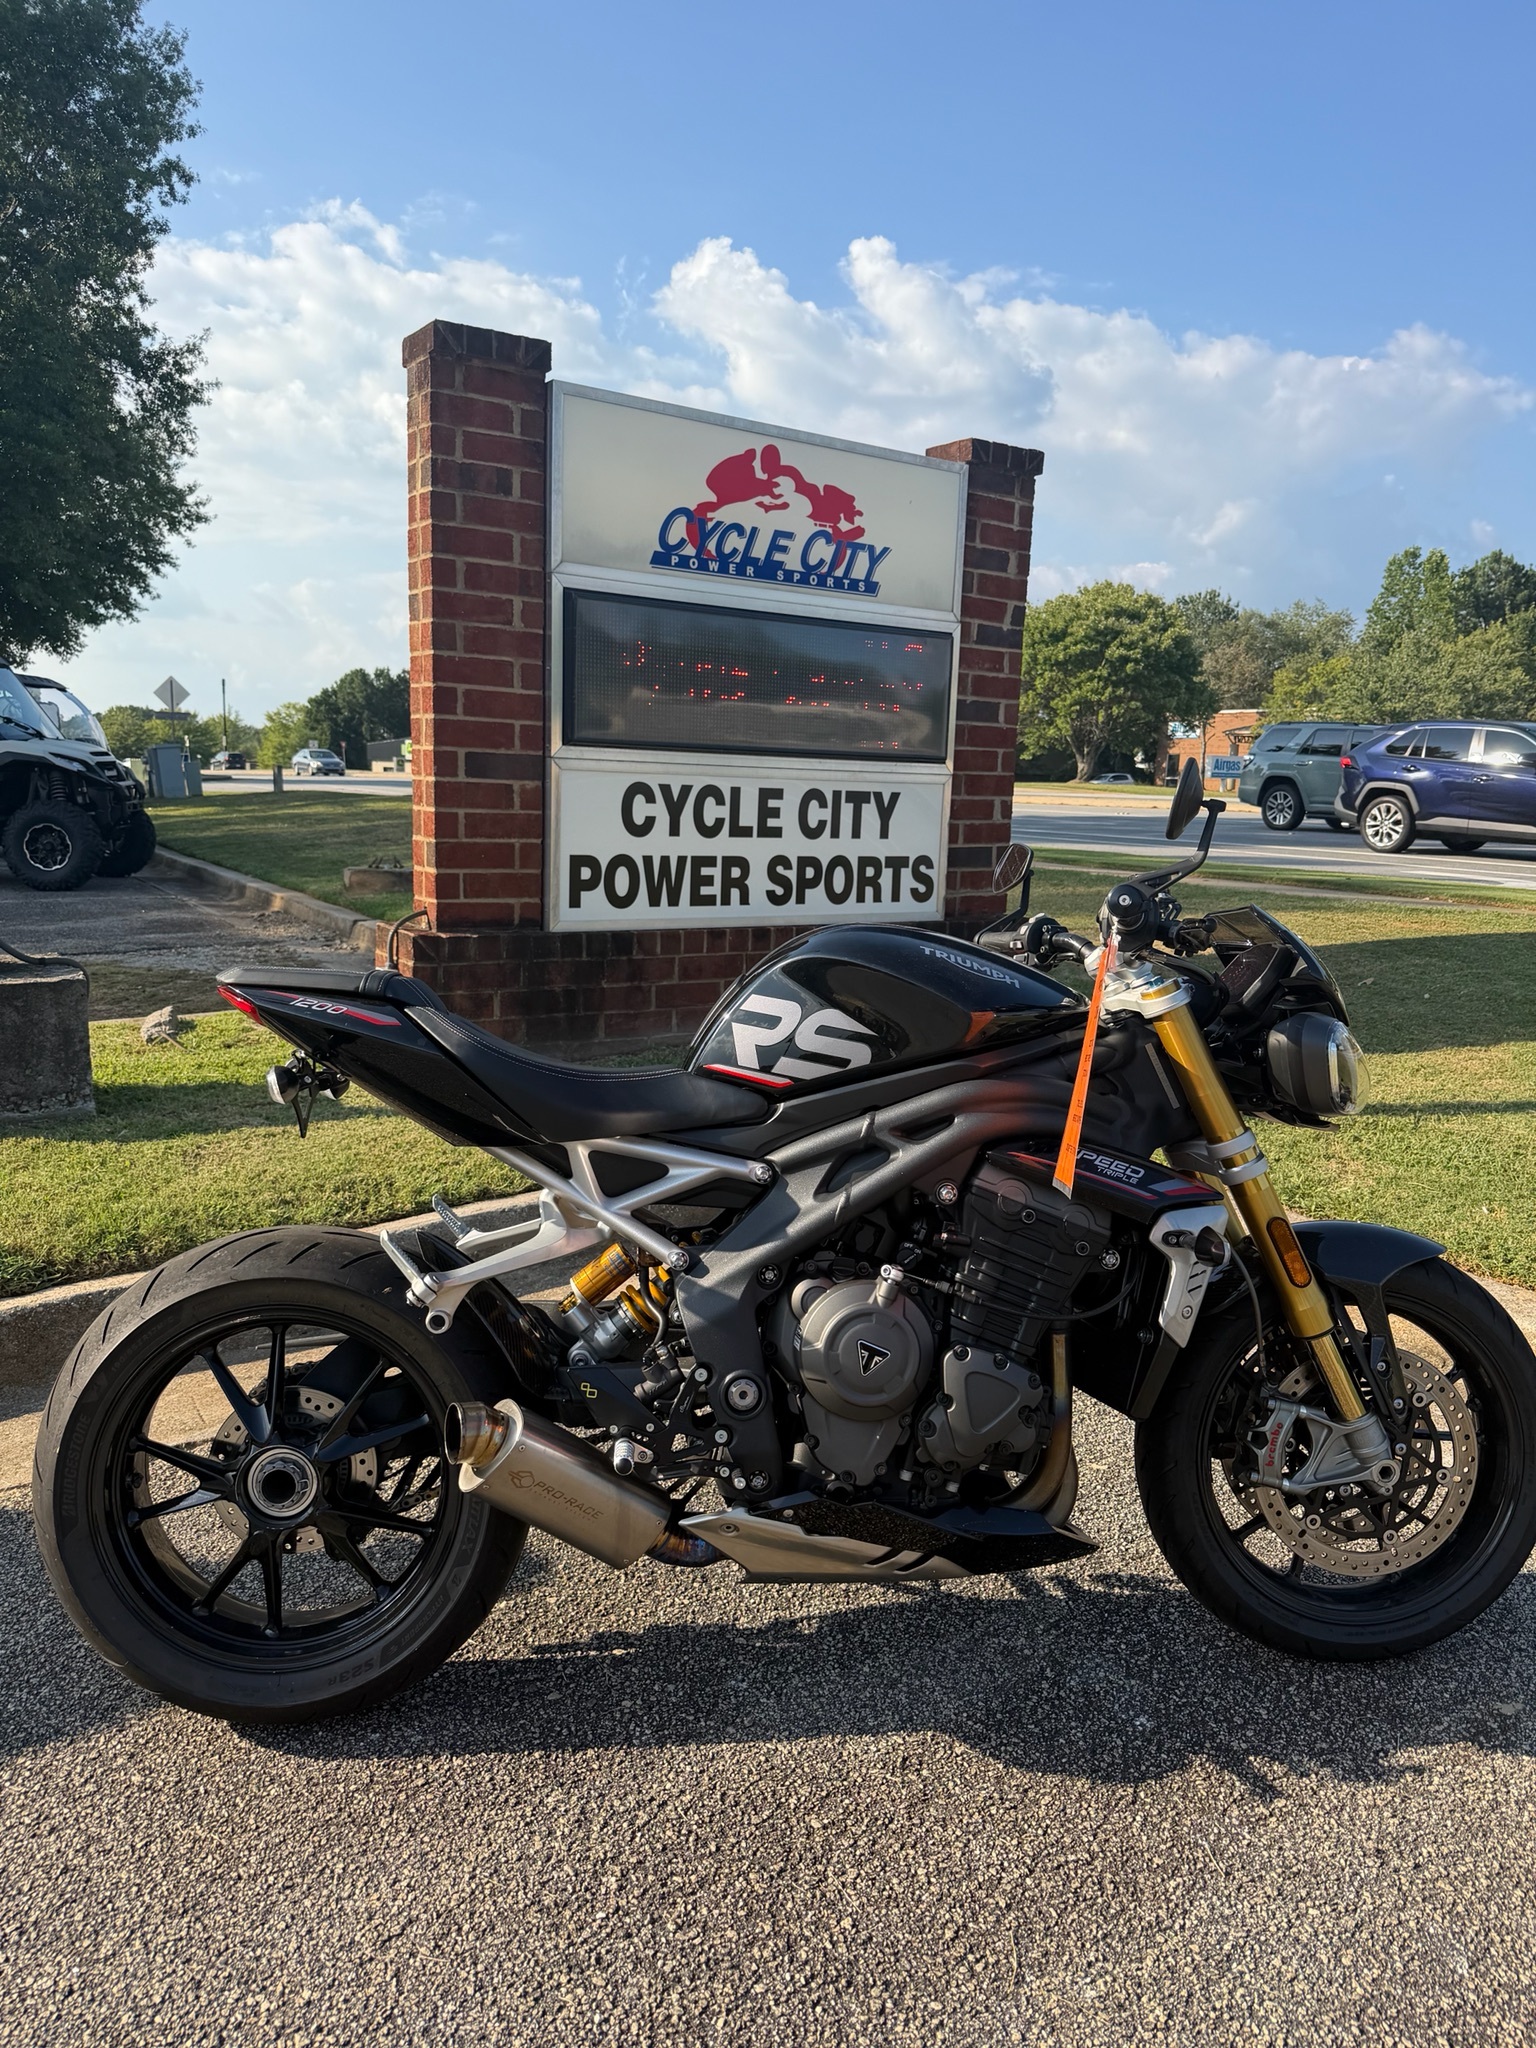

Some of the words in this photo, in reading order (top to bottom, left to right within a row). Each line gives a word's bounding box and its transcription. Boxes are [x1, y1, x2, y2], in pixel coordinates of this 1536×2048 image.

[658, 507, 796, 567] CYCLE
[800, 529, 892, 582] CITY
[671, 556, 756, 577] POWER
[776, 570, 866, 592] SPORTS
[1213, 759, 1241, 772] Airgas
[621, 781, 785, 839] CYCLE
[798, 788, 901, 840] CITY
[568, 853, 751, 909] POWER
[765, 854, 935, 906] SPORTS
[920, 945, 1020, 989] TRIUMPH
[289, 997, 348, 1014] 1200
[731, 993, 880, 1080] RS
[1077, 1148, 1146, 1179] PEED
[1097, 1165, 1140, 1185] TRIPLE
[61, 1413, 91, 1519] BRIDGESTONE
[1264, 1422, 1283, 1467] brembo
[534, 1480, 604, 1520] PRO-RACE
